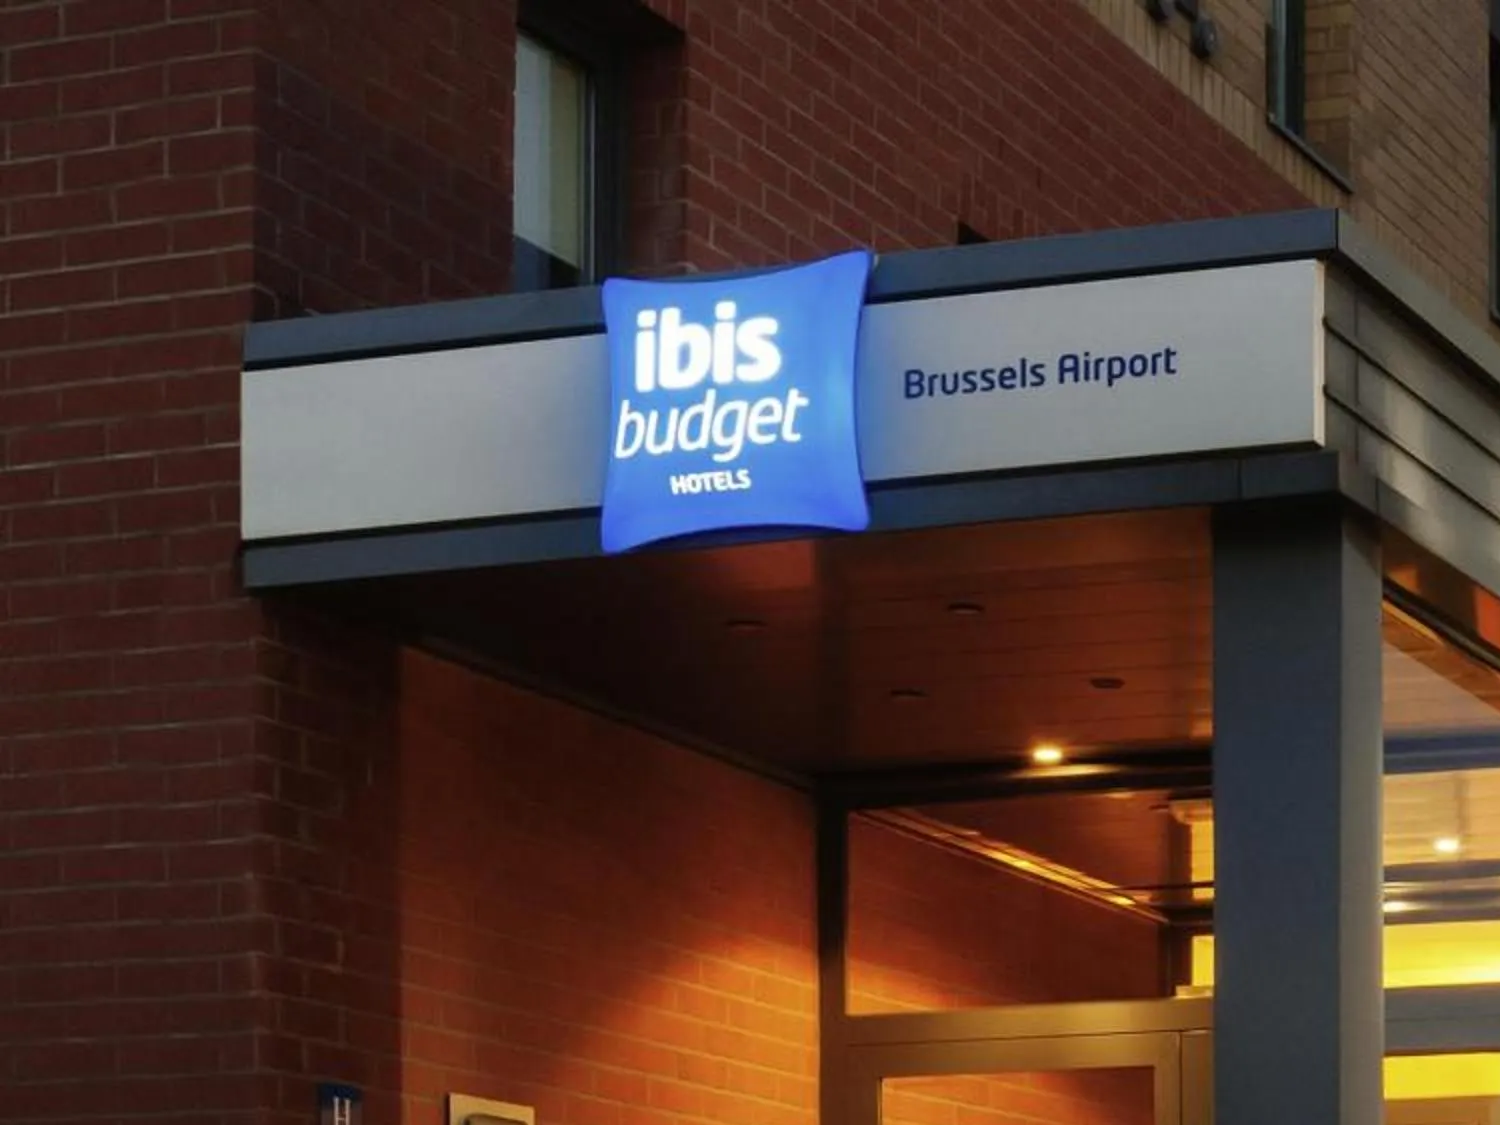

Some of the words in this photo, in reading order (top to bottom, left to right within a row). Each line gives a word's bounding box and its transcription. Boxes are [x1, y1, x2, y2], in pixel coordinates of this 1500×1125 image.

[634, 301, 781, 393] ibis
[903, 357, 1046, 399] Brussels
[1057, 347, 1177, 388] Airport
[615, 388, 809, 463] budget
[670, 469, 751, 495] HOTELS
